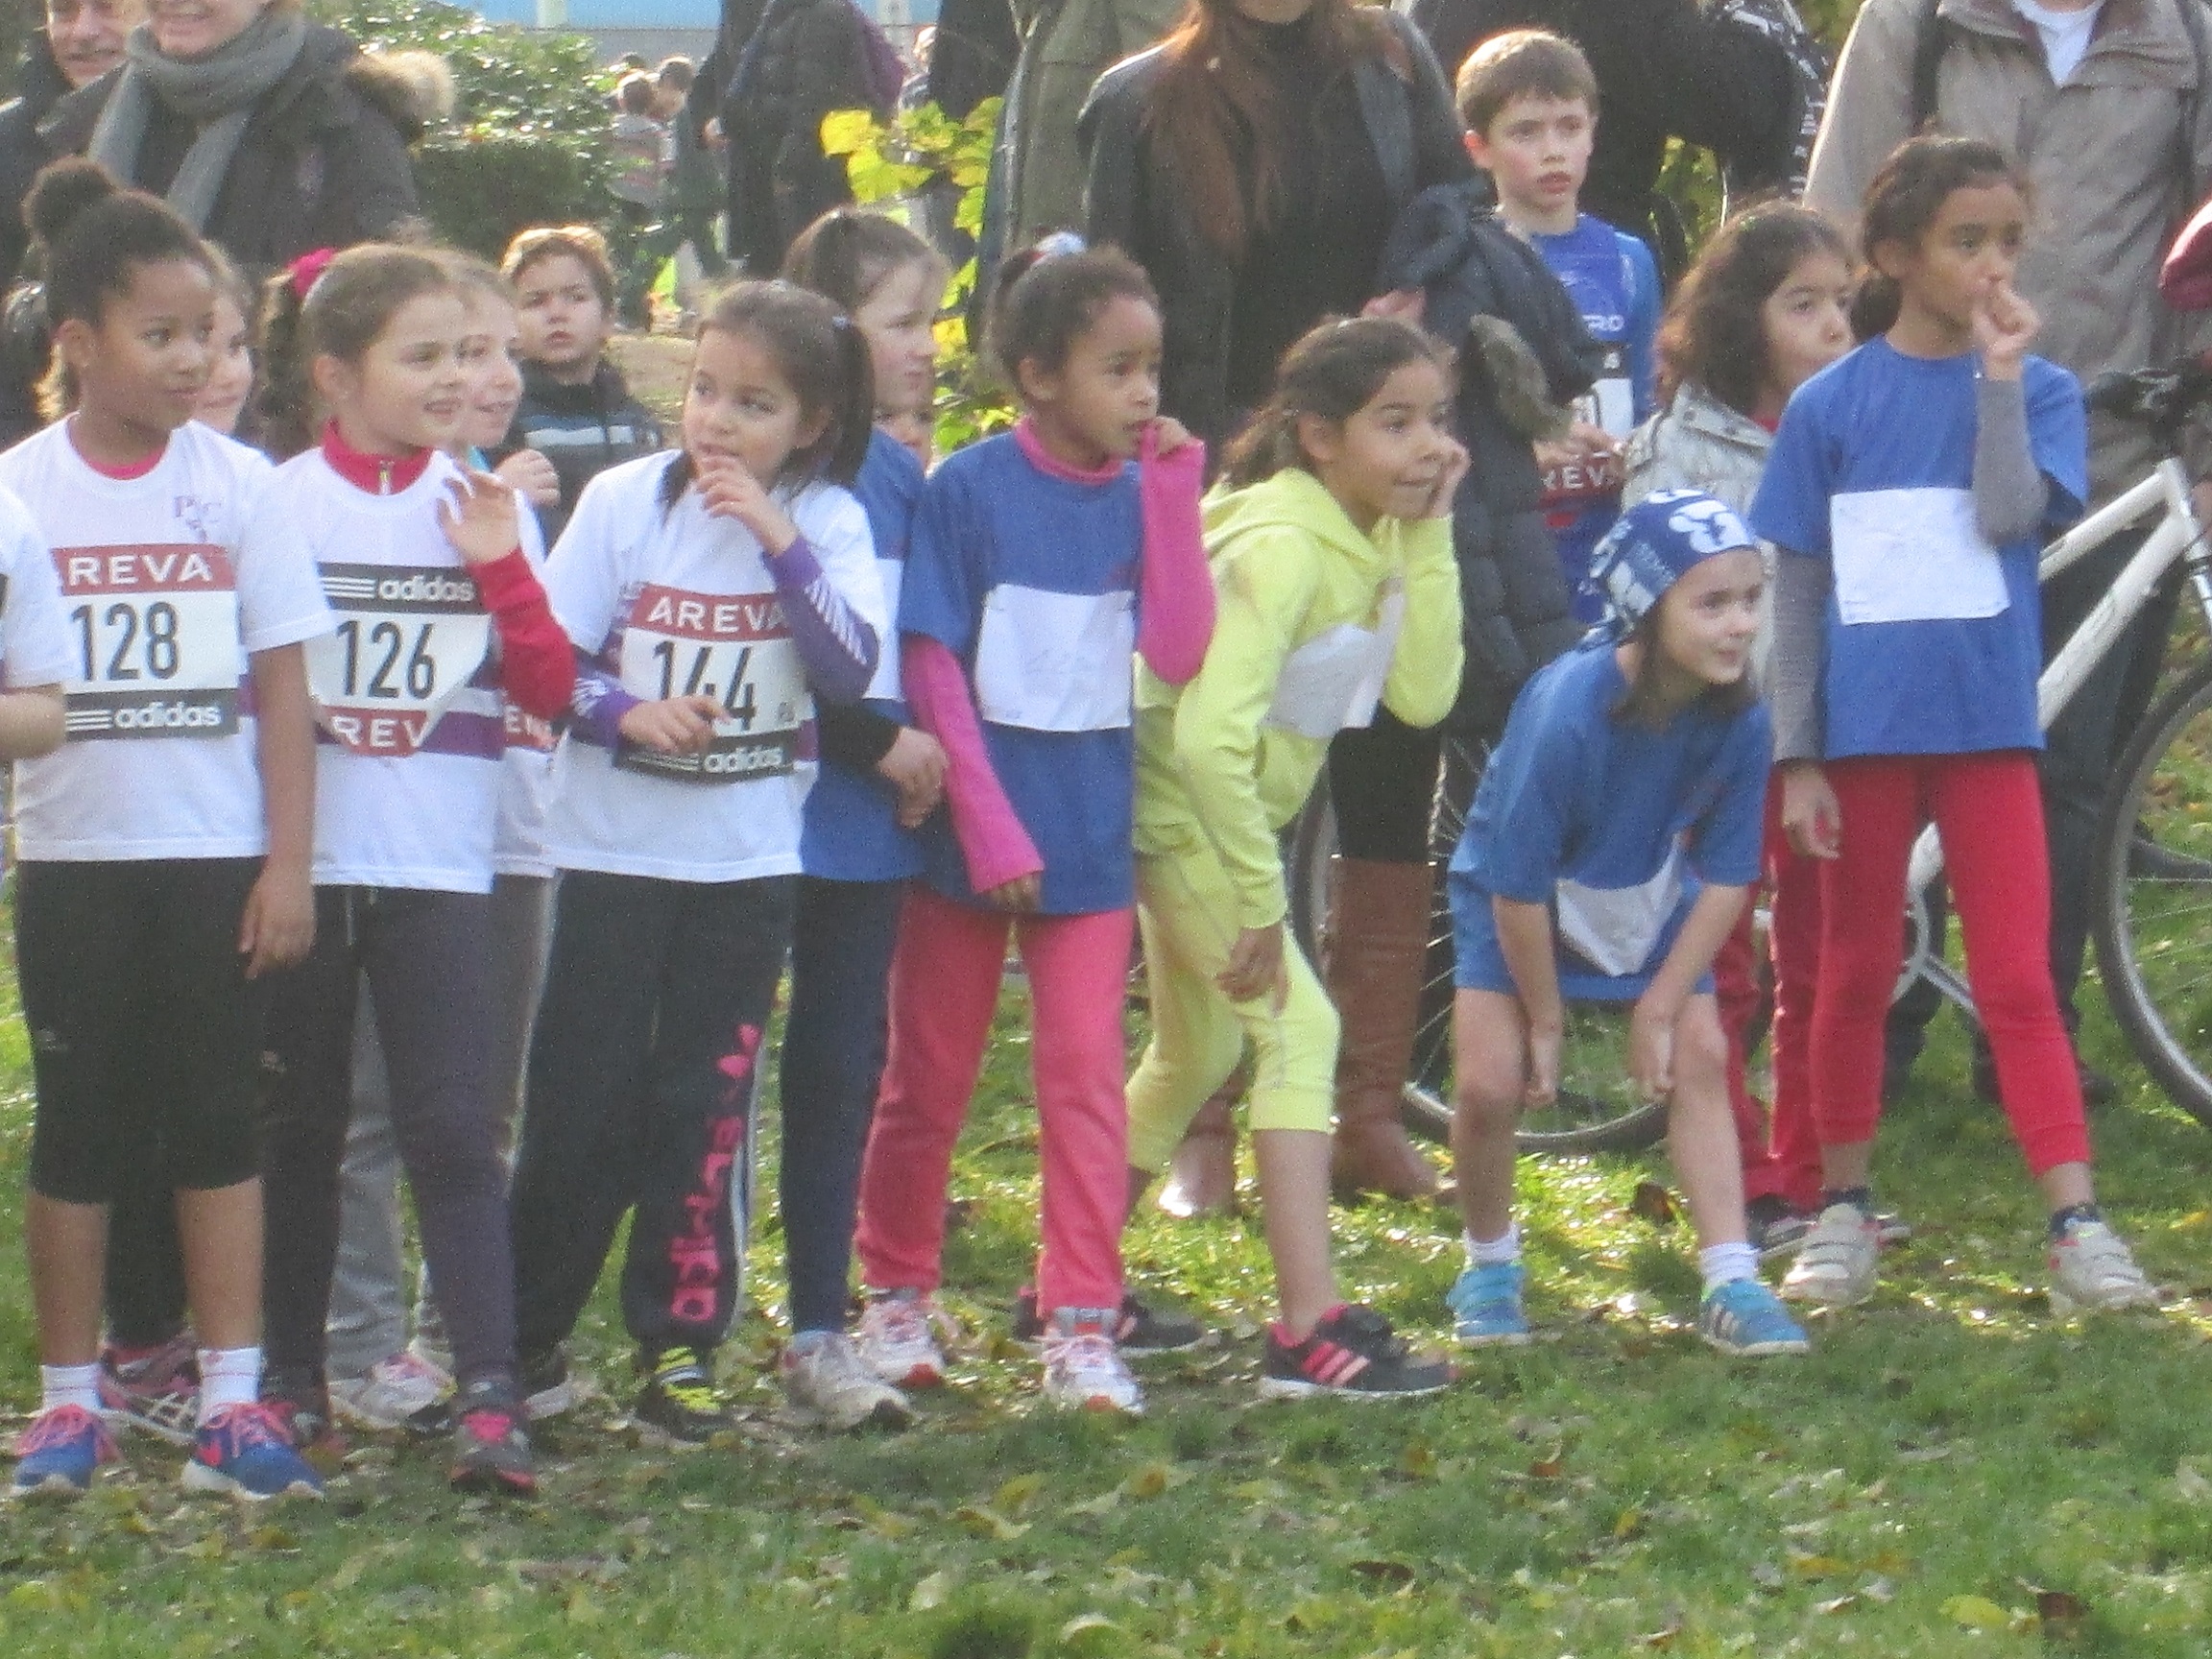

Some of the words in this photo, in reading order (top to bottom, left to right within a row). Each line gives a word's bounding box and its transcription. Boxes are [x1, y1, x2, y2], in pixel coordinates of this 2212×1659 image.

[67, 552, 214, 587] REVA
[378, 575, 477, 602] adidas
[71, 601, 179, 683] 128
[338, 619, 436, 700] 126
[654, 640, 757, 732] 144
[114, 701, 222, 728] adidas
[330, 715, 431, 748] REV
[703, 745, 783, 774] adidas
